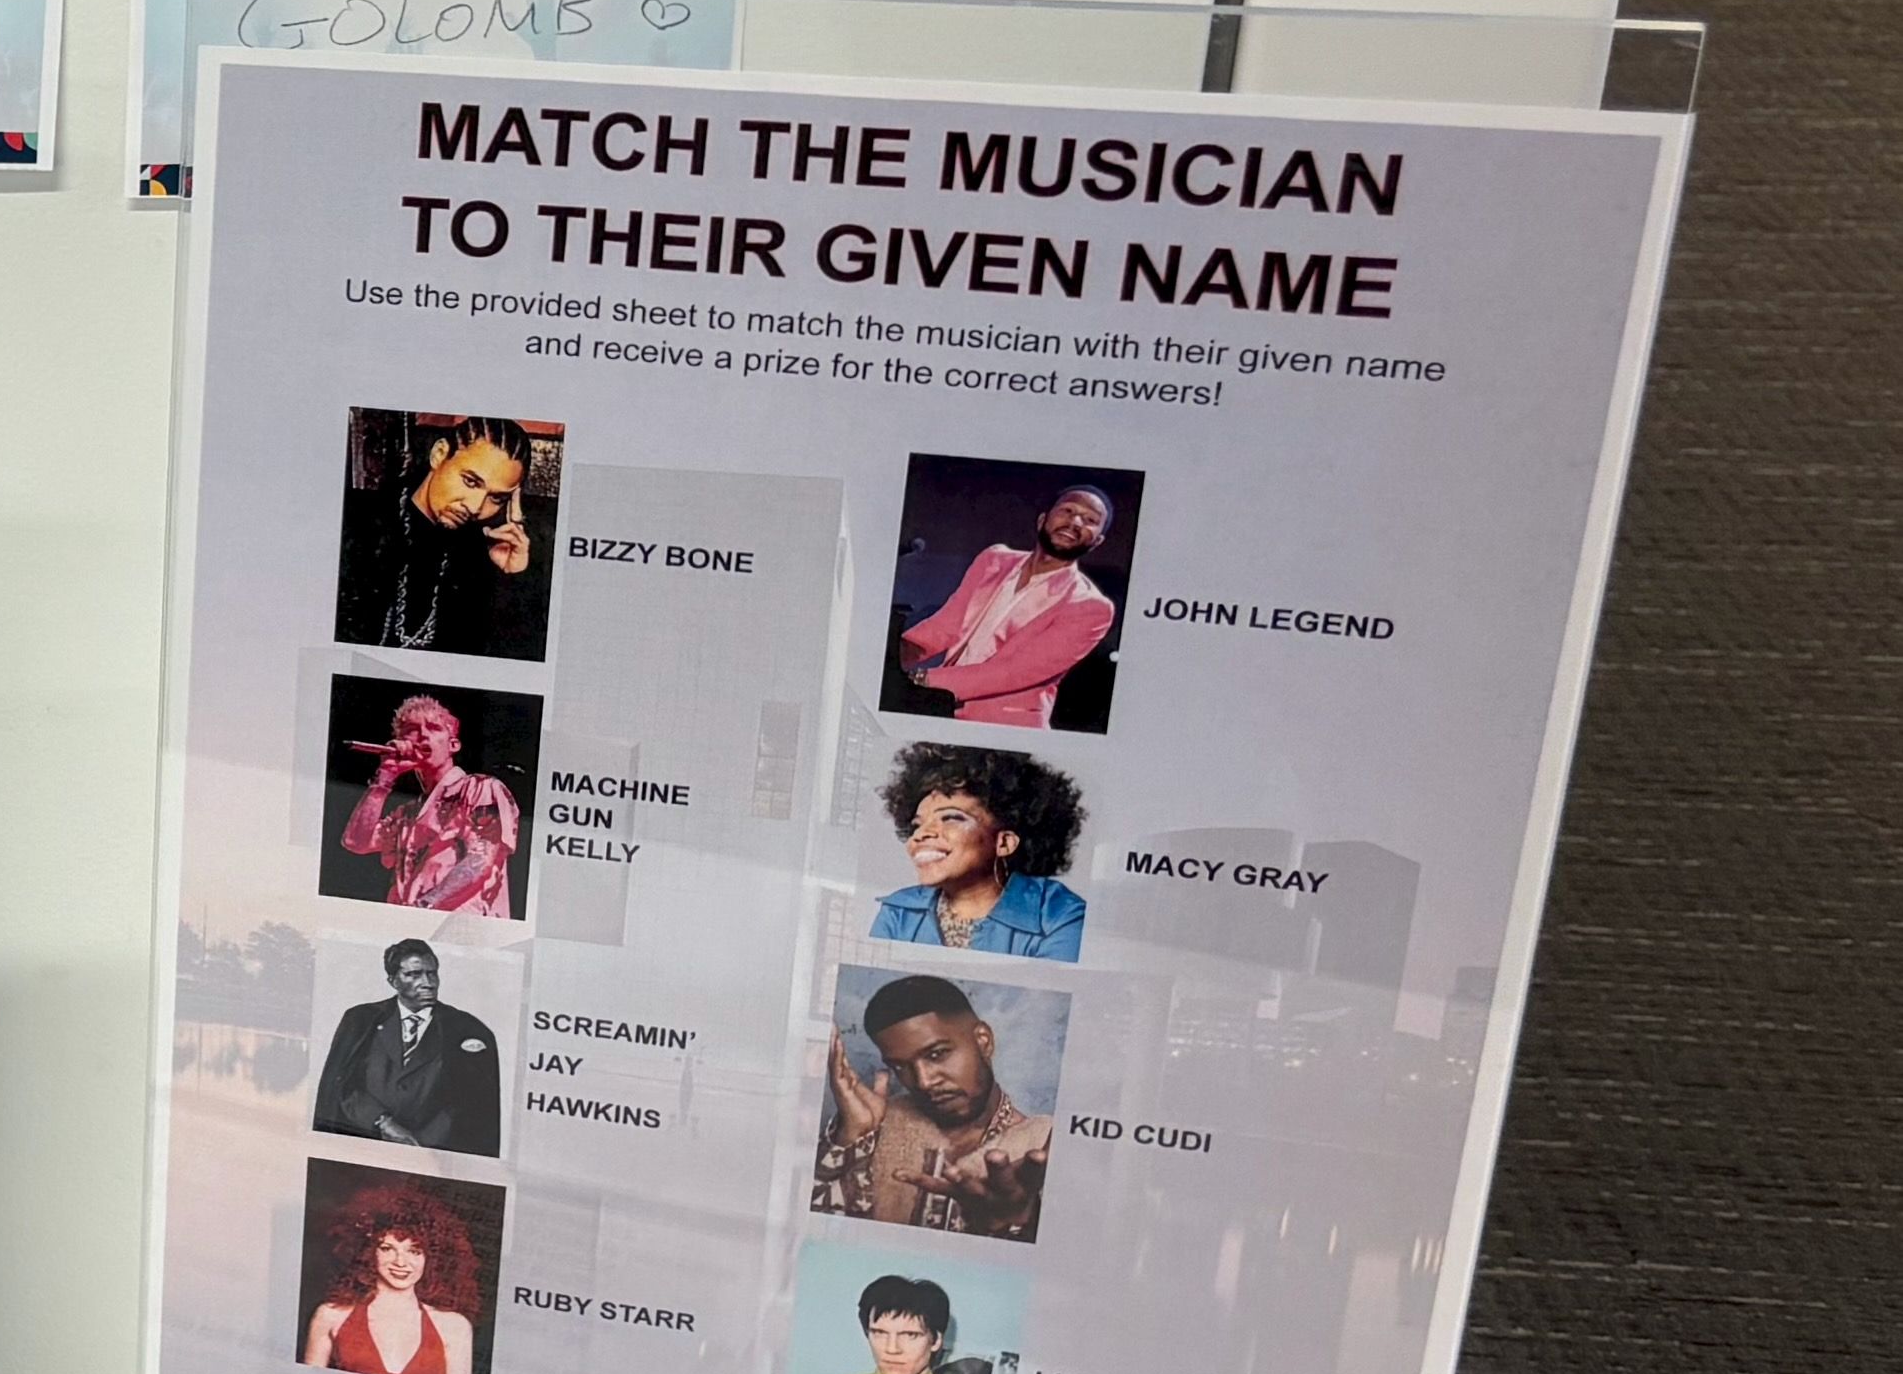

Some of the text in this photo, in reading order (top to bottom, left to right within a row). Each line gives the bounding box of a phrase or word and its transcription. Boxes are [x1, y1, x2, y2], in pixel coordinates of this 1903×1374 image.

[418, 102, 1403, 216] MATCH THE MUSICIAN
[402, 196, 1398, 319] TO THEIR GIVEN NAME
[525, 333, 1222, 406] and receive a prize for the correct answers!
[569, 537, 754, 573] BIZZY BONE
[1143, 597, 1394, 639] JOHN LEGEND
[551, 771, 690, 806] MACHINE
[549, 804, 612, 829] GUN
[546, 834, 640, 863] KELLY
[1126, 851, 1329, 893] MACY GRAY
[533, 1011, 696, 1049] SCREAMIN'
[529, 1052, 583, 1076] JAY
[527, 1092, 660, 1128] HAWKINS
[1070, 1115, 1211, 1153] KID CUDI
[514, 1286, 694, 1332] RUBY STARR
